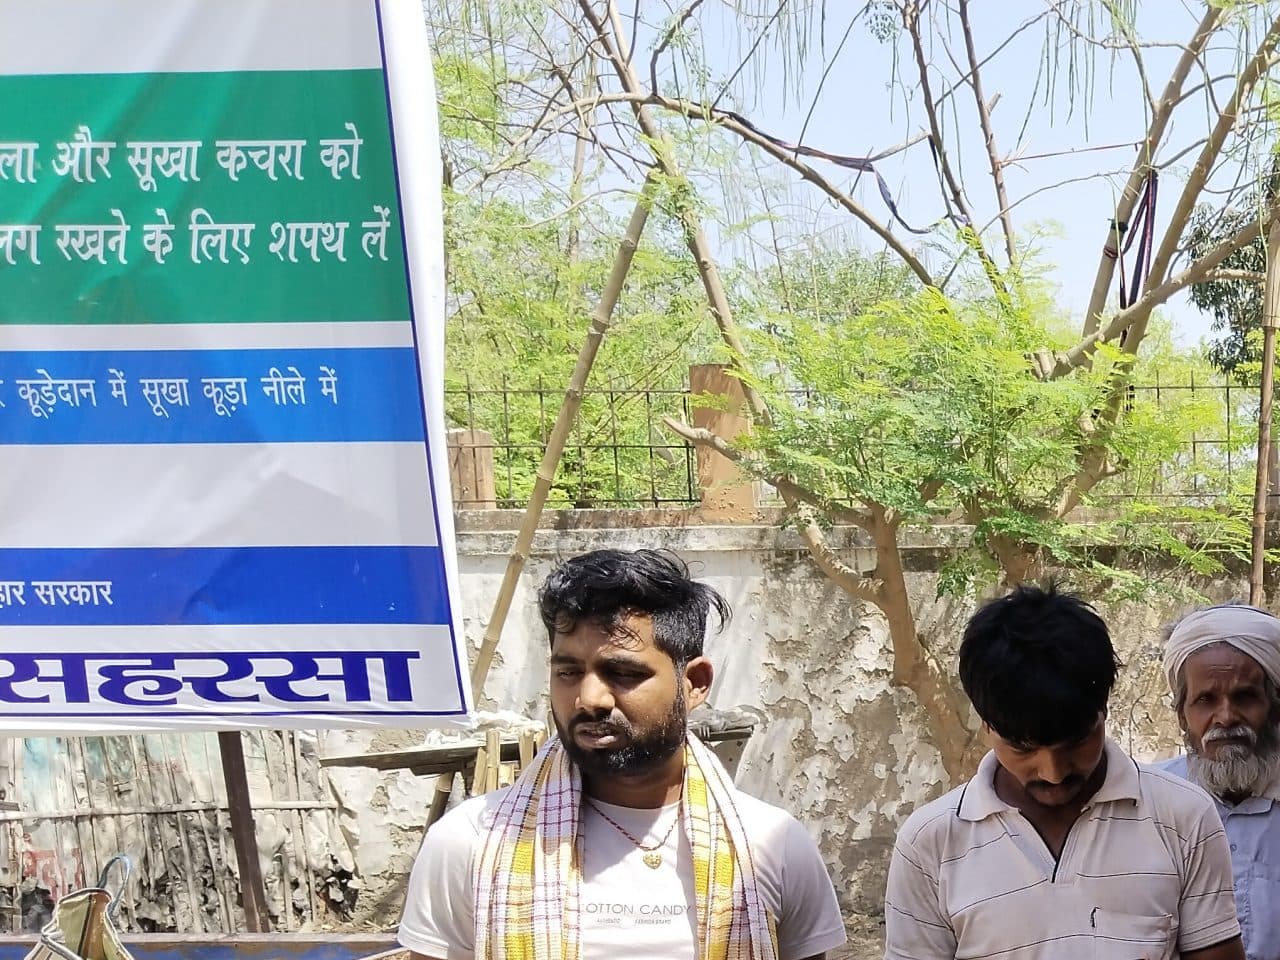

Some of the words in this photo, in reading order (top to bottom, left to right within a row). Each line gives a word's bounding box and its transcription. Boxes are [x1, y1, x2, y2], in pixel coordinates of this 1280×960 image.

[52, 125, 116, 182] और
[127, 141, 202, 191] सूखा
[216, 140, 306, 181] कचरा
[320, 123, 363, 179] को
[55, 209, 130, 264] रखने
[143, 208, 175, 263] के
[189, 208, 255, 264] लिए
[269, 222, 349, 262] शपथ
[362, 206, 390, 260] लें
[16, 369, 96, 418] कूड़ेदान
[109, 369, 126, 405] में
[140, 379, 188, 417] सूखा
[202, 379, 246, 416] कूड़ा
[261, 367, 305, 404] नीले
[319, 367, 337, 403] में
[32, 582, 113, 605] सरकार
[0, 651, 419, 704] सहरसा
[582, 903, 634, 914] OTTON
[640, 904, 691, 915] CANDY
